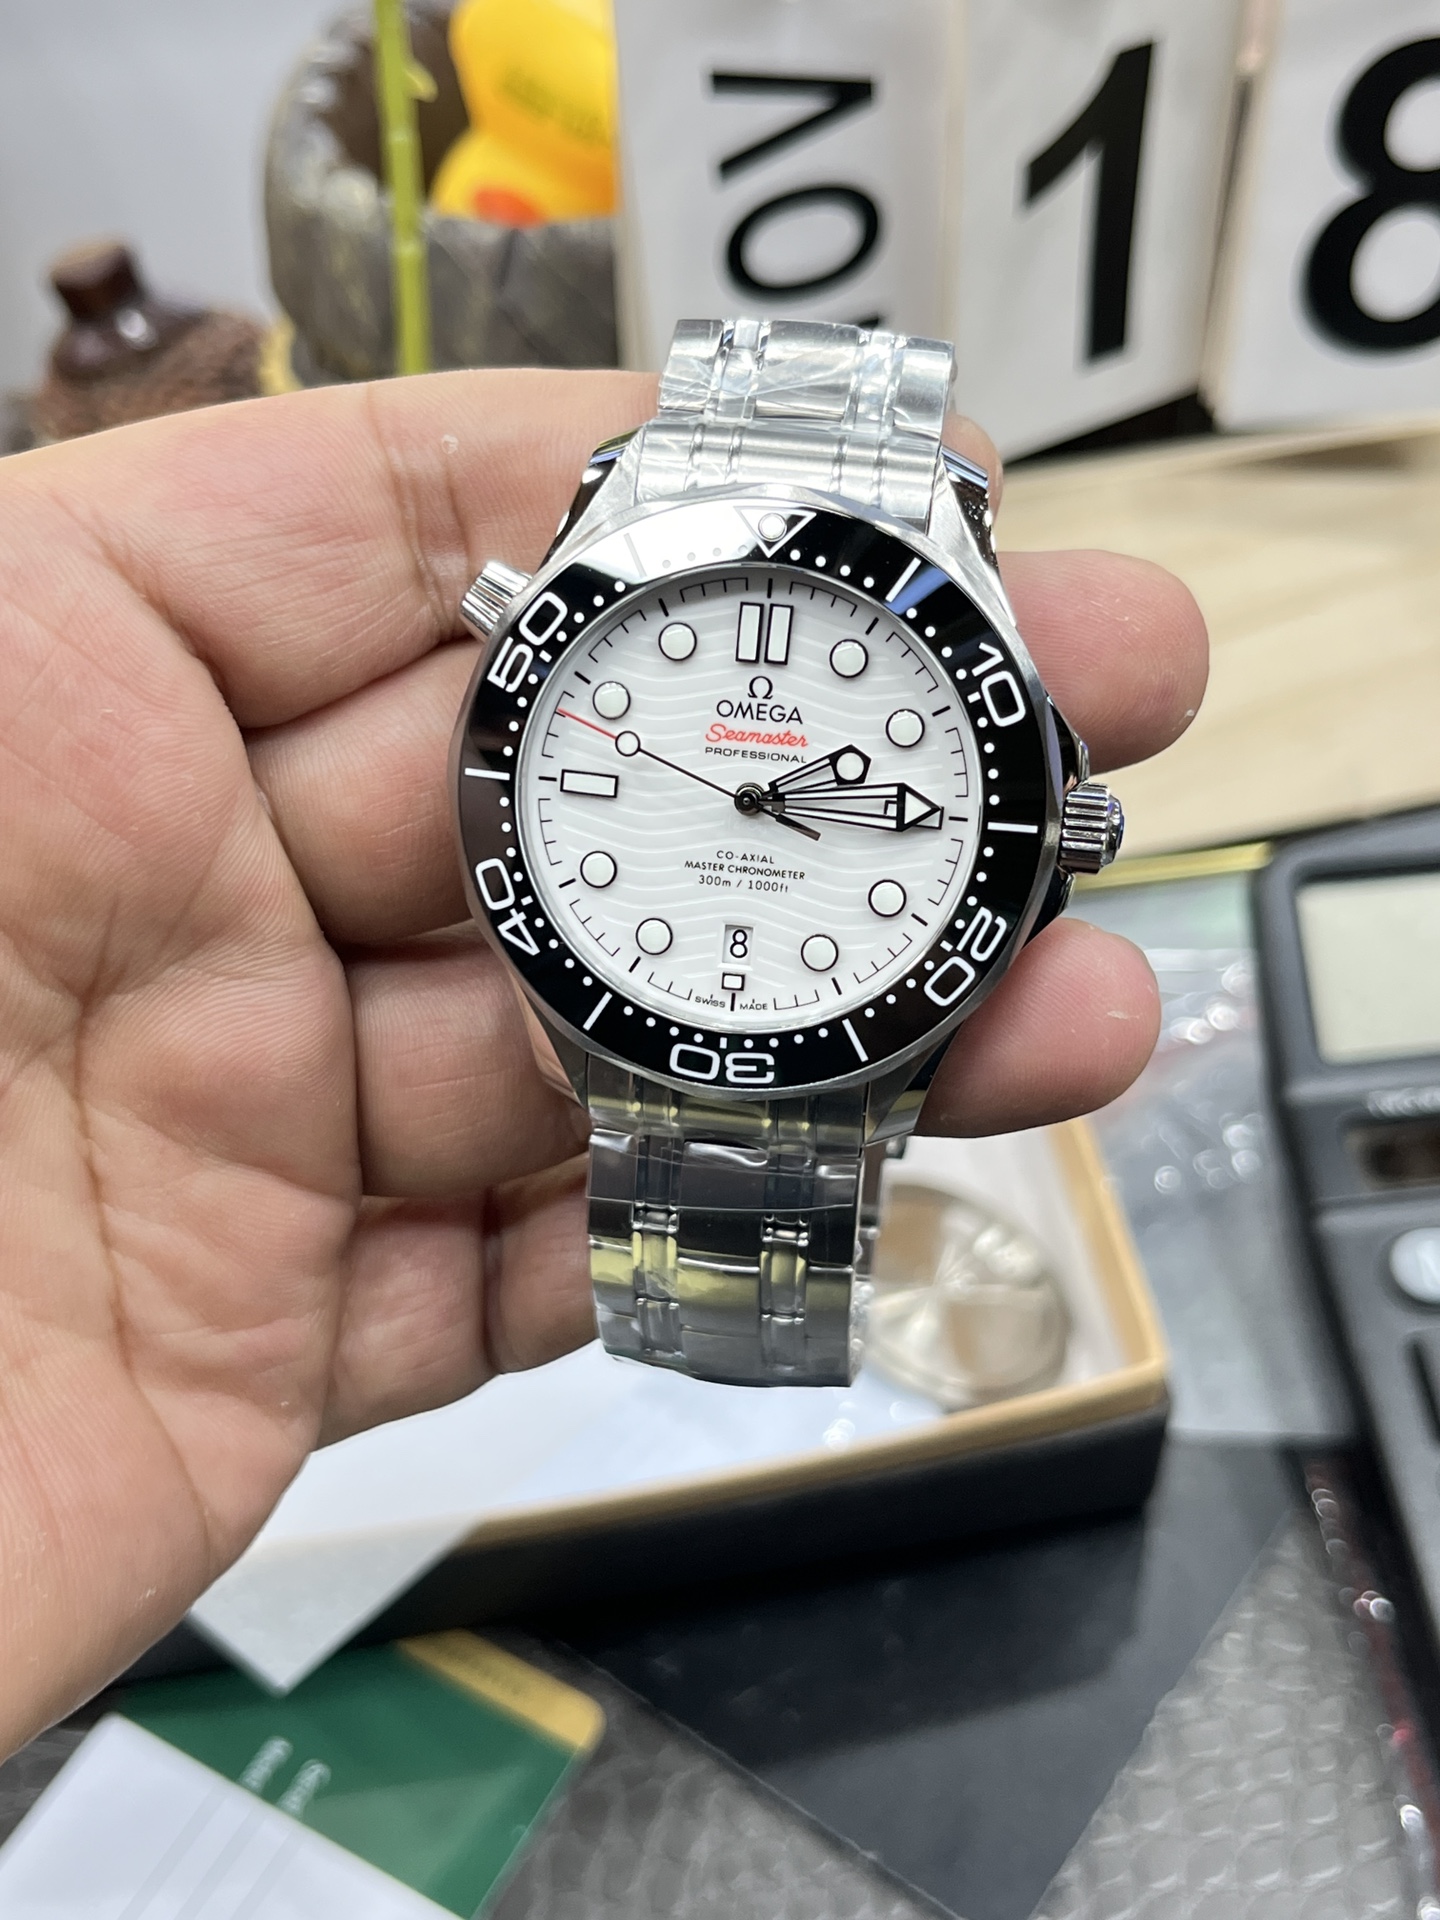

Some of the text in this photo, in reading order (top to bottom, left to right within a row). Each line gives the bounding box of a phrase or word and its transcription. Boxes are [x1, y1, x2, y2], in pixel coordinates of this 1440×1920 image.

[711, 70, 882, 330] OV
[486, 591, 569, 693] 50
[970, 641, 1026, 727] 10
[716, 699, 803, 725] OMEGA
[705, 723, 808, 748] Seamaster
[705, 746, 807, 764] PROFESSIONAL
[684, 860, 805, 880] MASTER CHRONOMETER
[716, 850, 774, 864] CO-AXIAL
[698, 874, 731, 887] 300m
[748, 880, 788, 893] 1000ft
[475, 857, 541, 956] 40
[729, 929, 748, 959] 8
[923, 906, 1007, 1007] 20
[694, 996, 768, 1011] SWISS MADE
[669, 1042, 775, 1084] 30
